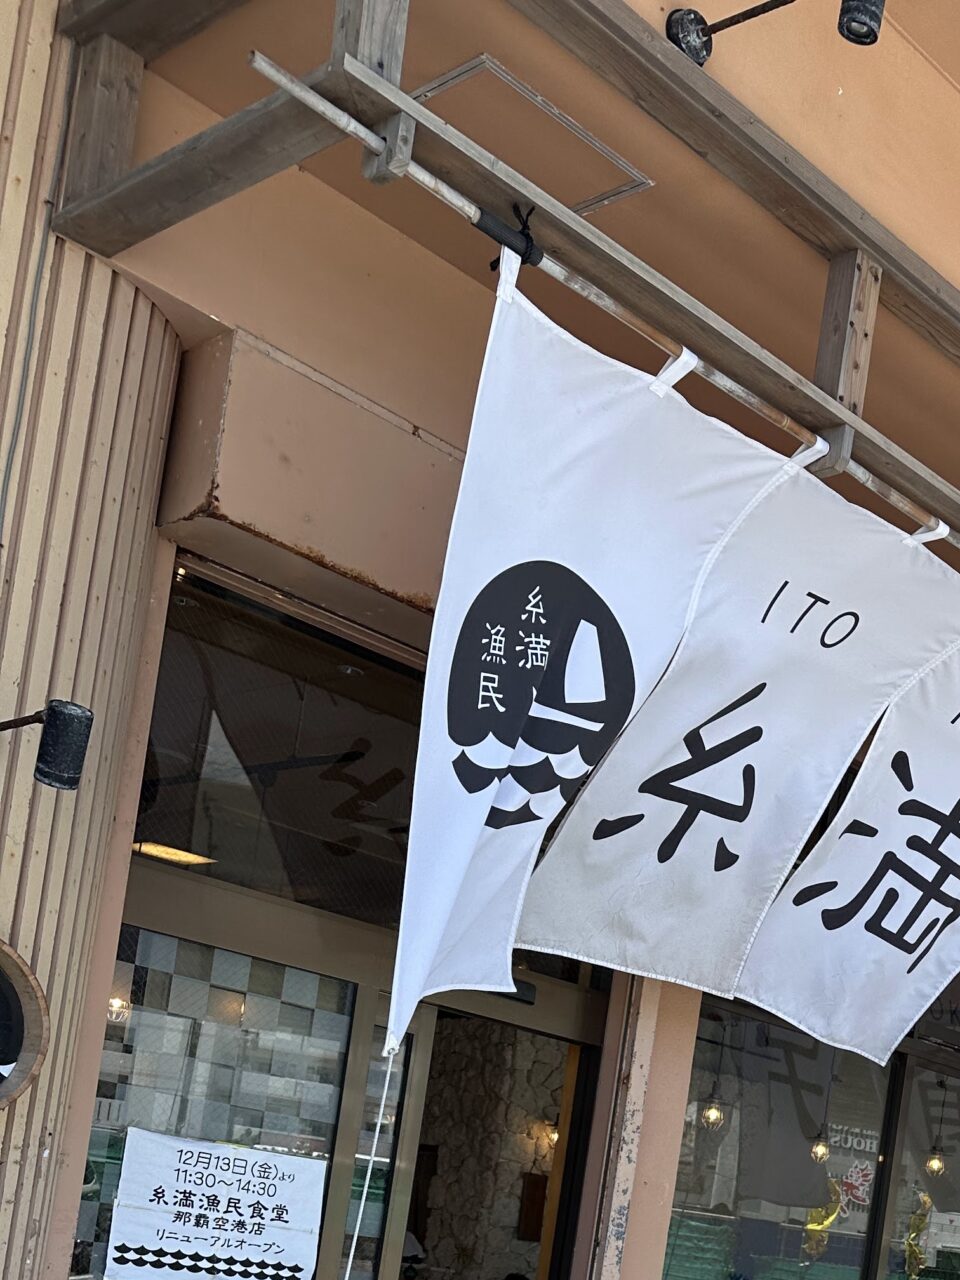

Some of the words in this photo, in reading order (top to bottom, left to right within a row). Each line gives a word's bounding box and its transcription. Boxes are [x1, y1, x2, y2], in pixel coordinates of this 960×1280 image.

[761, 579, 859, 649] ITO
[148, 1185, 290, 1224] 糸満漁民食堂
[156, 1229, 286, 1255] リニューアルオープン
